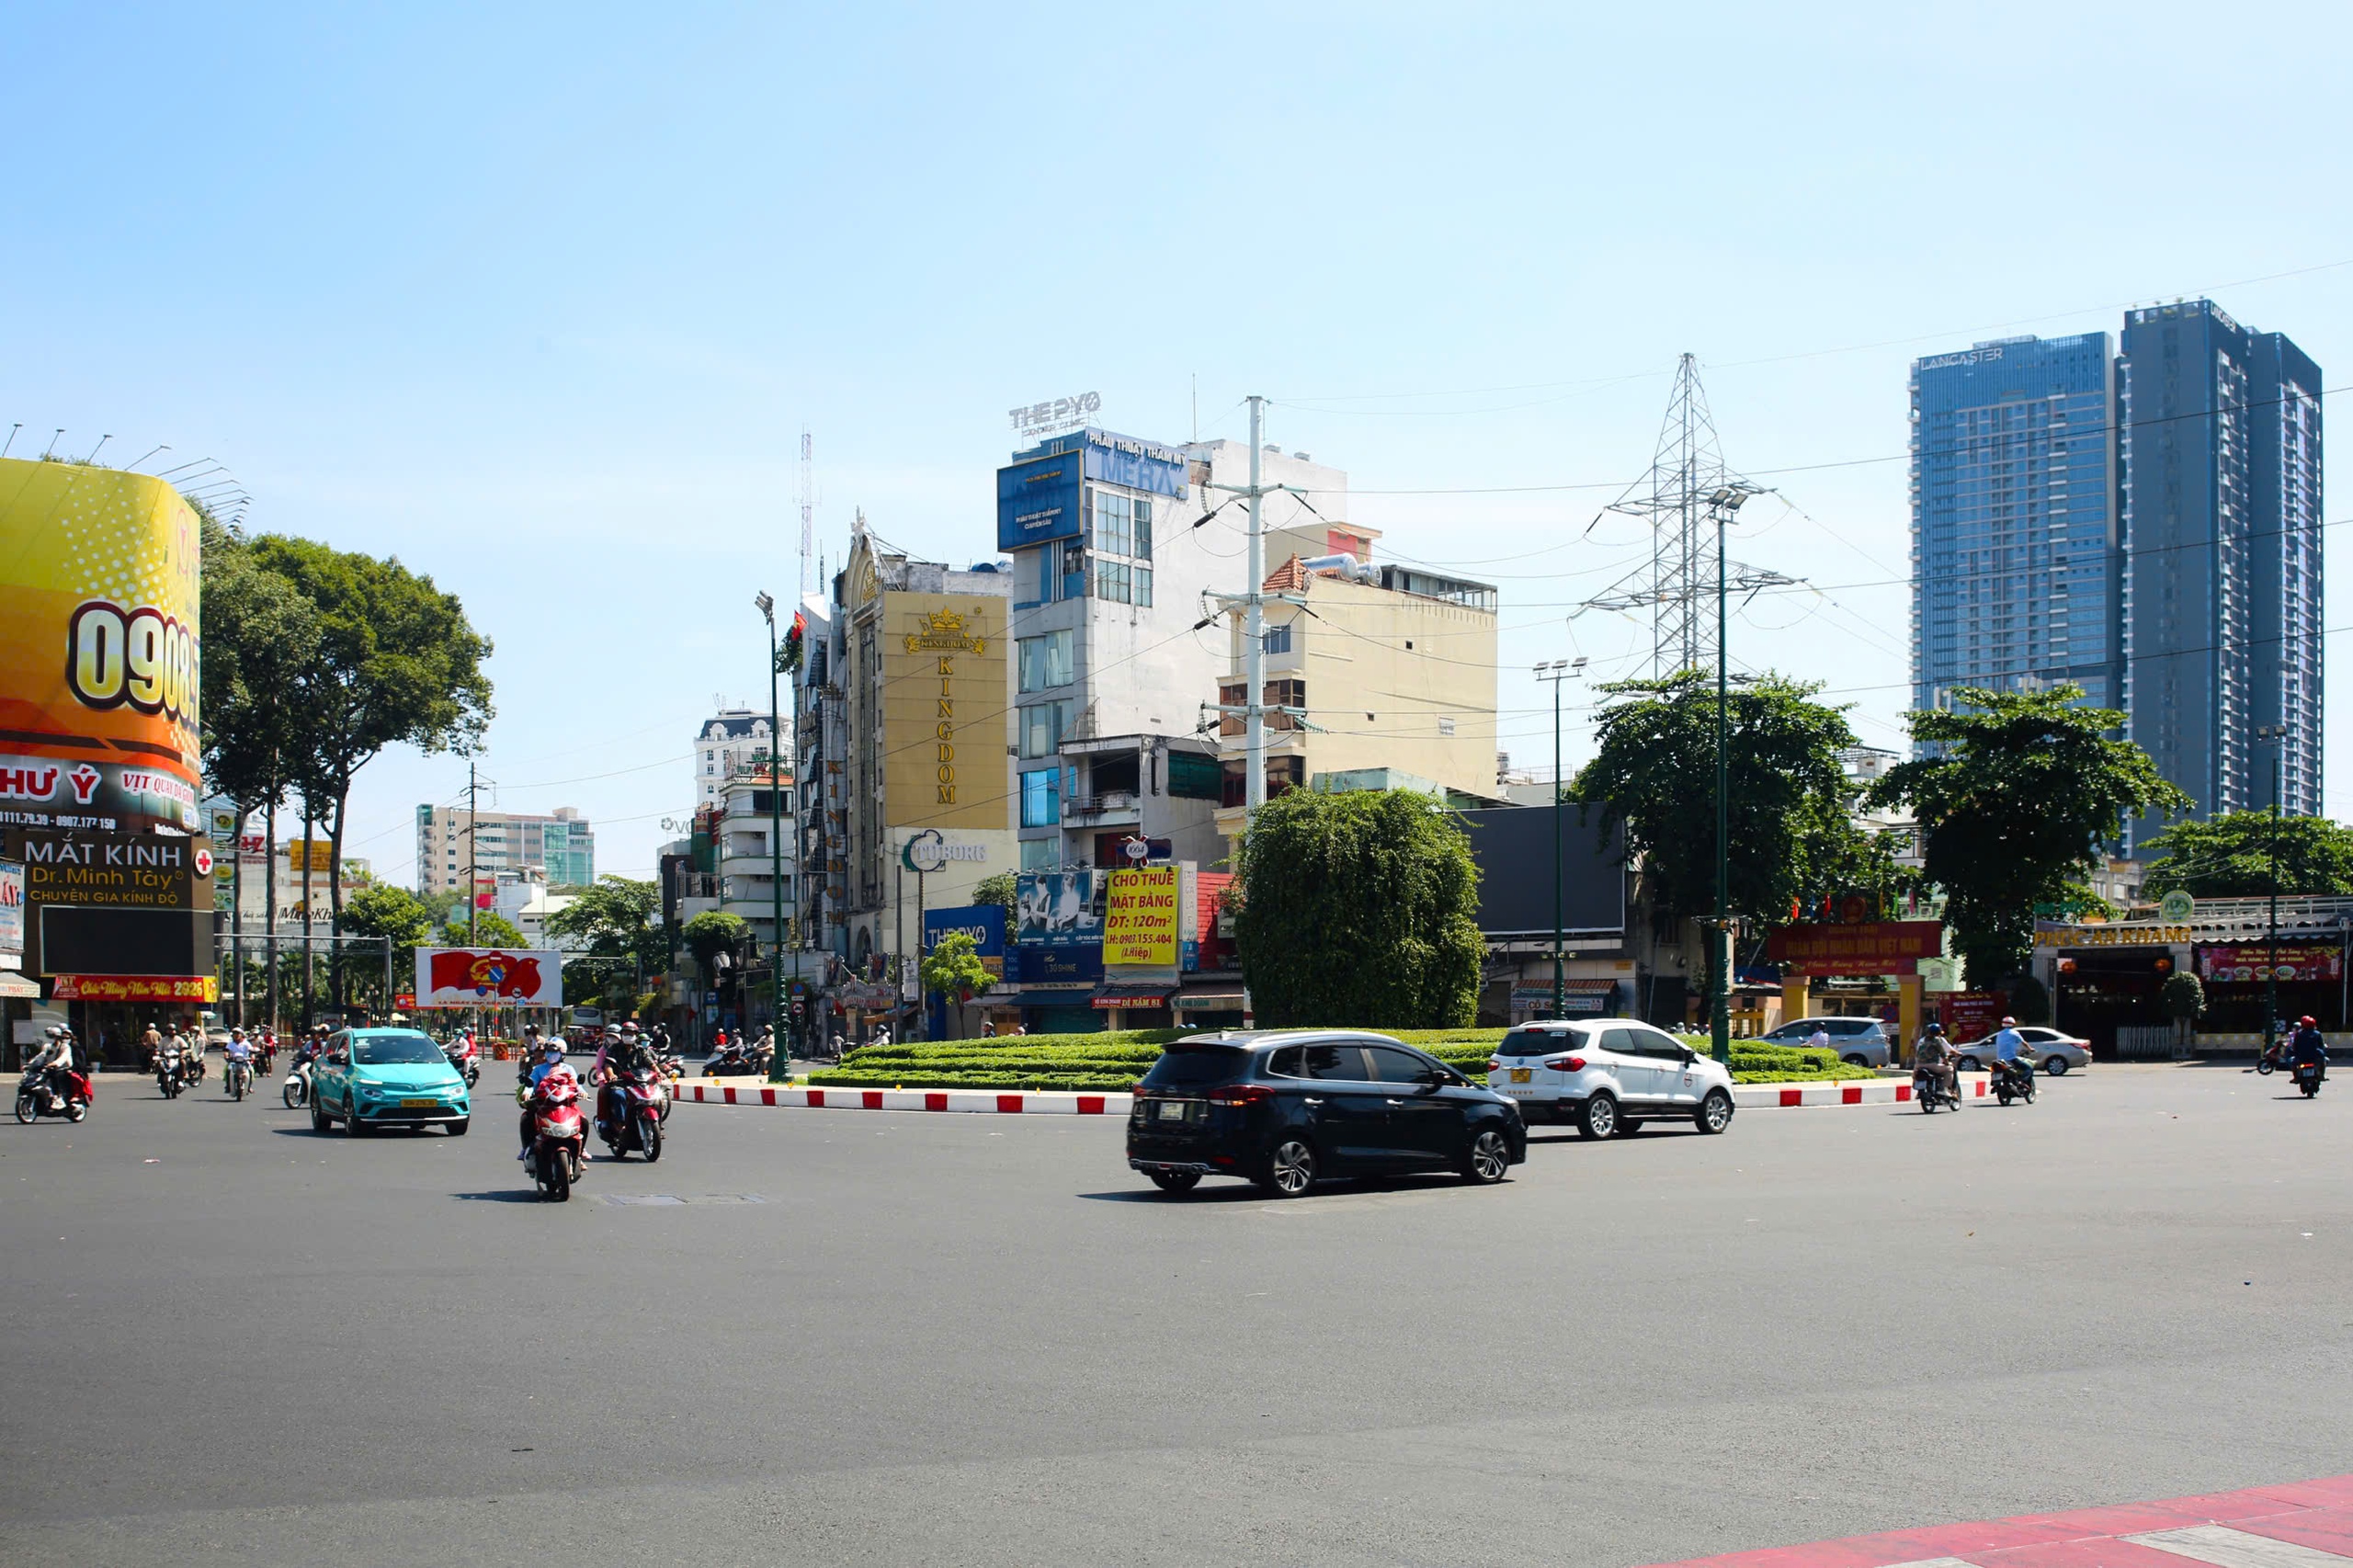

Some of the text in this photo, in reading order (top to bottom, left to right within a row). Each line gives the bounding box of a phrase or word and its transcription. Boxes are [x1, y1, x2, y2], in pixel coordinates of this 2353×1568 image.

[1921, 347, 2003, 370] LANCASTER
[1009, 402, 1051, 428] THE
[937, 656, 957, 805] KINGDOM
[56, 814, 117, 830] 0907.177150
[25, 832, 180, 867] MẮT KÍNH
[915, 844, 988, 862] TUBORG
[132, 869, 172, 890] Tây
[1112, 870, 1175, 887] CHO THUÊ
[30, 888, 178, 906] CHUYÊN GIA KÍNH ĐỘ
[1110, 893, 1136, 912] MẶT
[1108, 915, 1130, 928] DT:
[1106, 934, 1118, 944] LH:
[1119, 933, 1172, 944] 0903.155.404
[2089, 929, 2117, 946] AN
[2120, 926, 2192, 945] KHANG
